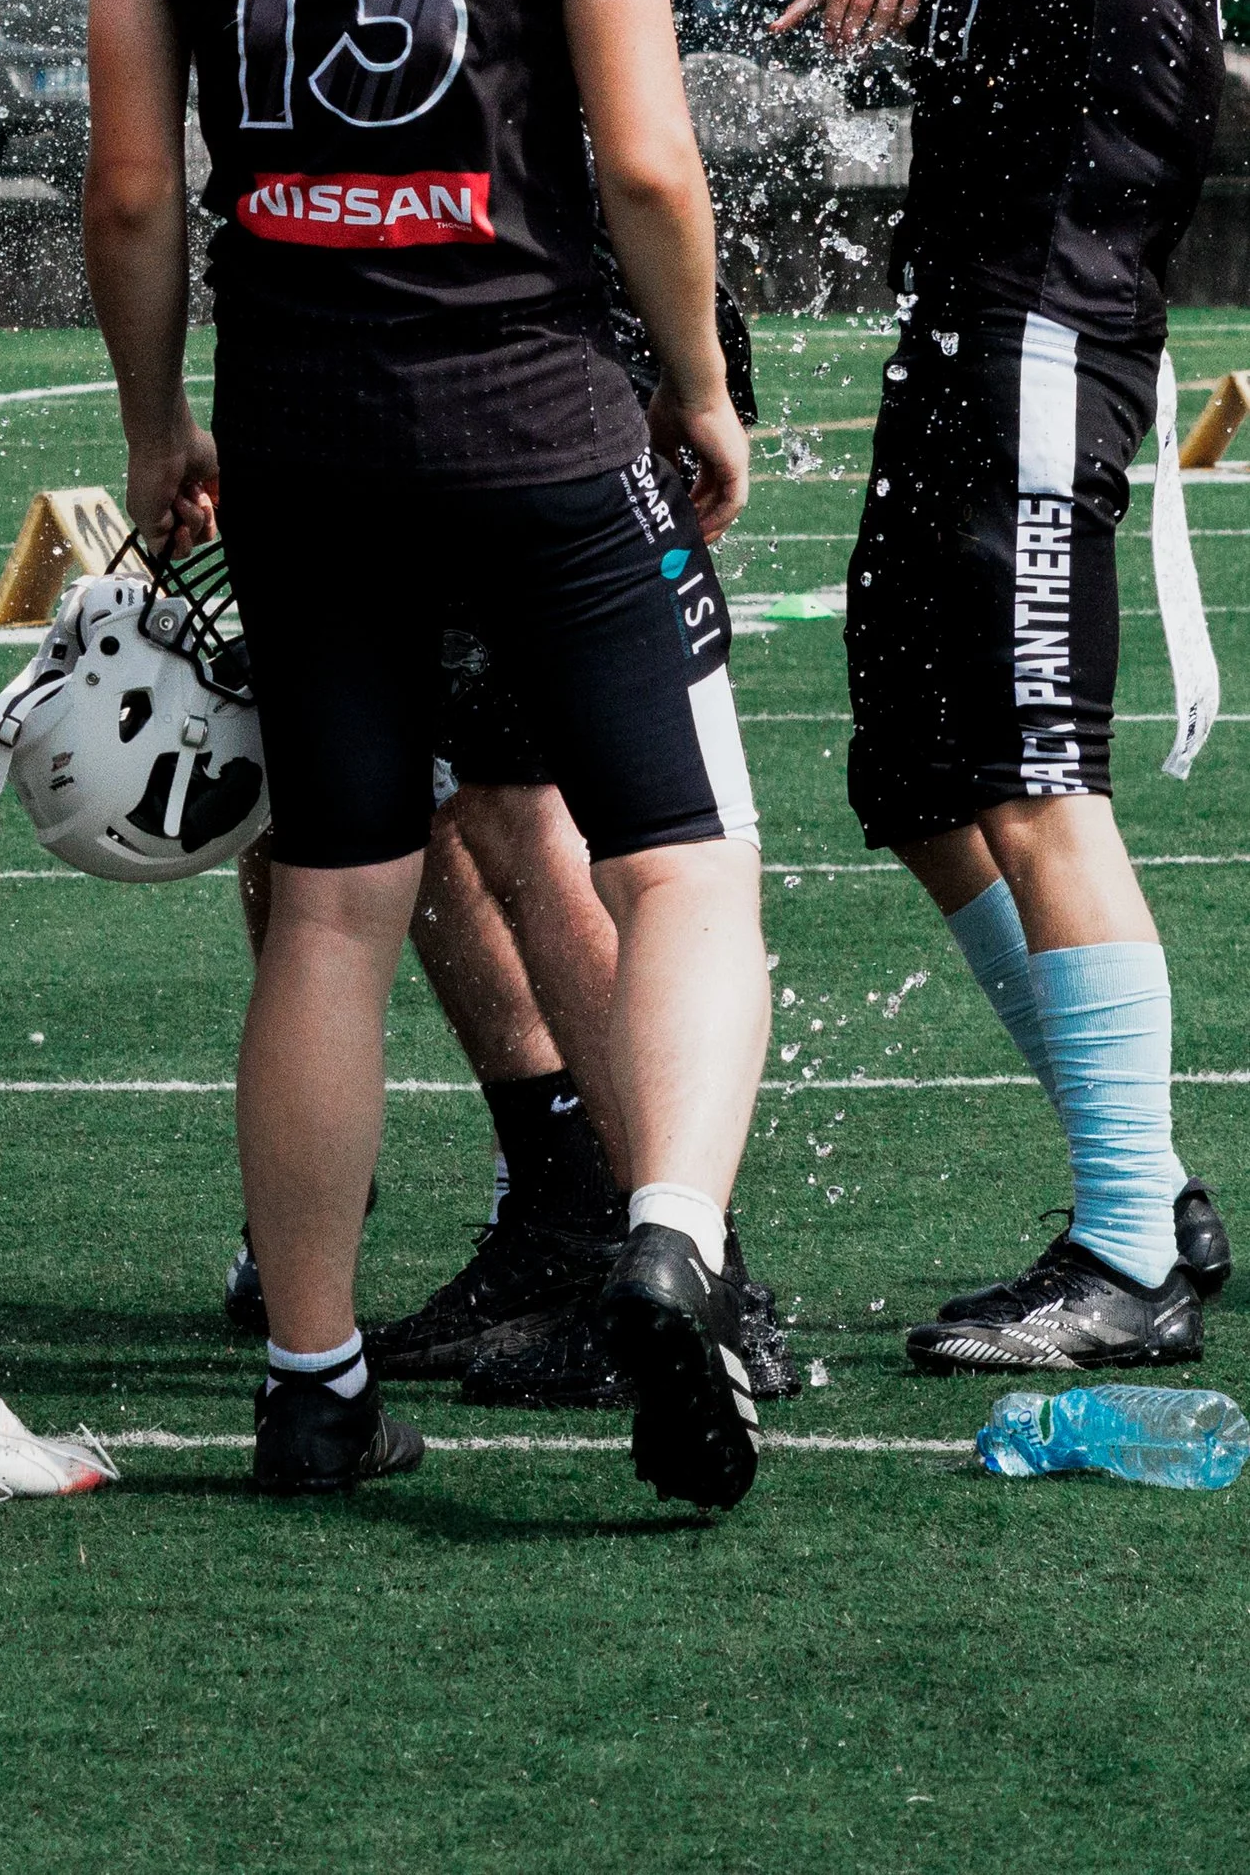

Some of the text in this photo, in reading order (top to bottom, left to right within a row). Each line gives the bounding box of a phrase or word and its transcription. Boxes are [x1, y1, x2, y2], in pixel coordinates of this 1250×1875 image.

[249, 182, 473, 226] NISSAN
[676, 571, 721, 656] ISL
[1014, 498, 1073, 707] PANTHERS
